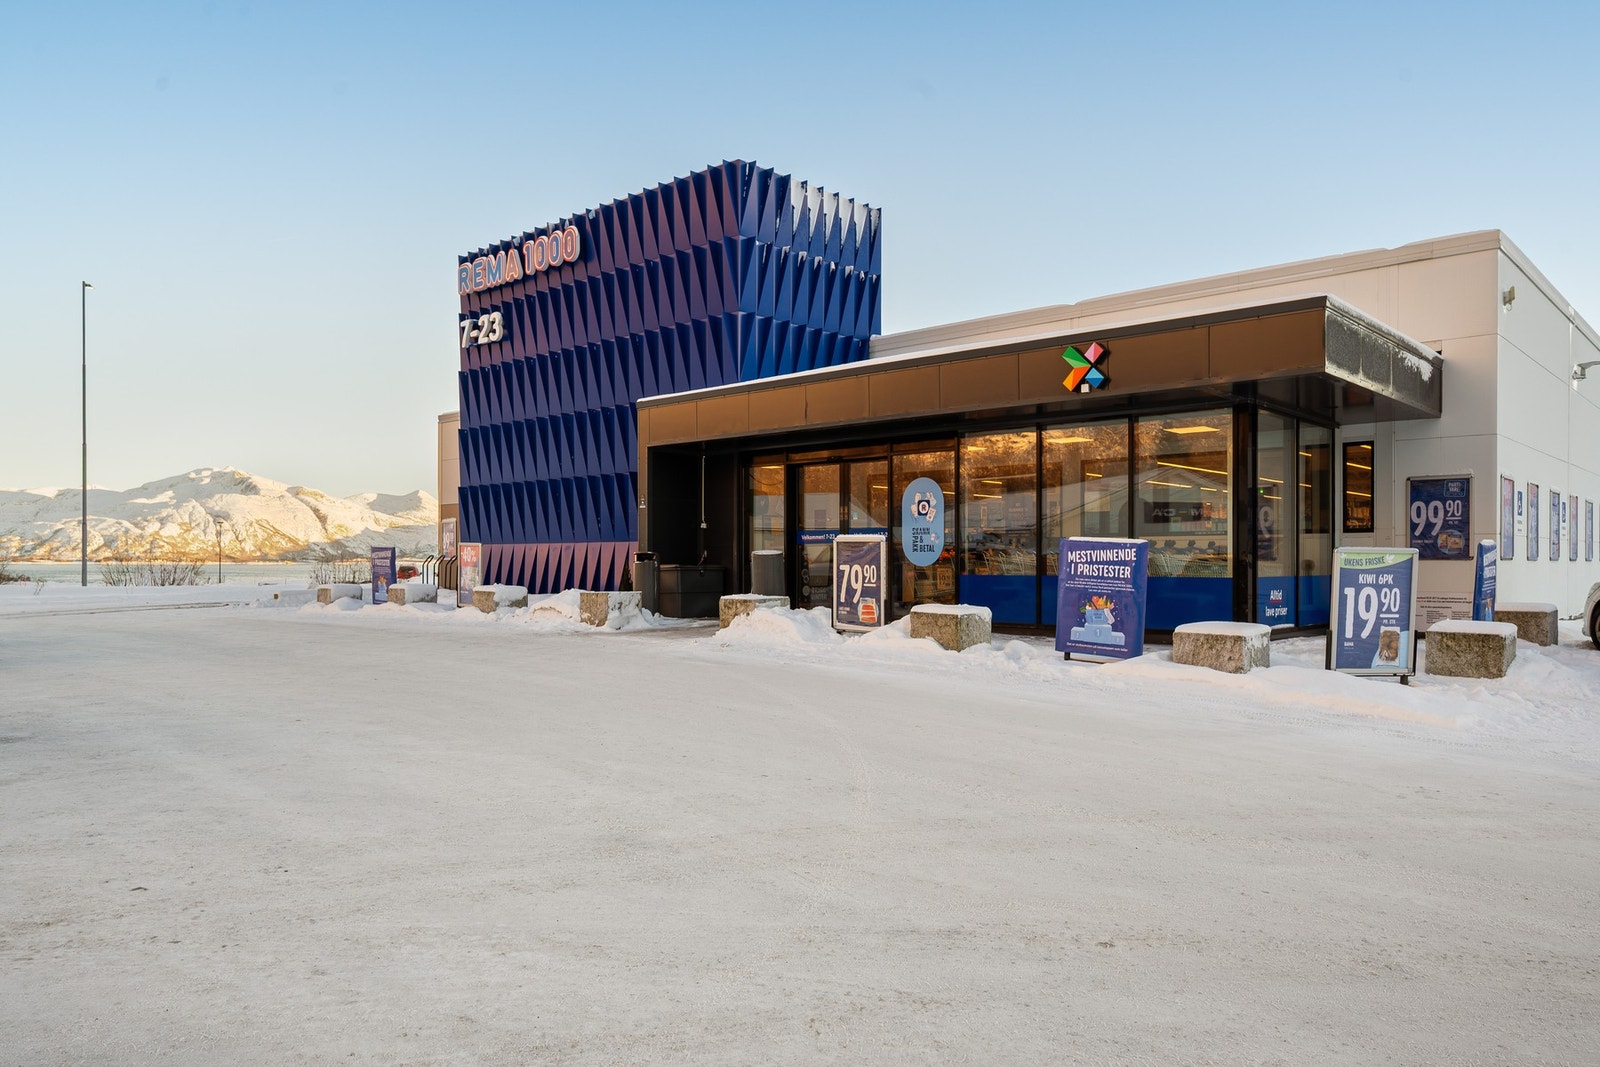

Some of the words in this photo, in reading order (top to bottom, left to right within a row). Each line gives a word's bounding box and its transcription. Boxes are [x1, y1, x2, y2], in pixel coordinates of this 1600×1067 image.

[458, 249, 523, 295] REMA
[523, 226, 580, 276] 1000
[460, 311, 503, 348] 7-23
[1411, 500, 1445, 537] 99
[1445, 500, 1462, 517] 90
[919, 544, 936, 553] BETAL
[1067, 548, 1137, 562] MESTVINNENDE
[1344, 557, 1364, 567] UKENS
[1365, 555, 1386, 566] FRISKE
[1071, 563, 1075, 575] I
[1077, 563, 1131, 578] PRISTESTER
[1358, 573, 1376, 585] KIWI
[1378, 573, 1394, 585] 6PK
[839, 564, 863, 604] 79
[863, 564, 877, 584] 90
[1344, 586, 1379, 640] 19
[1380, 587, 1401, 613] 90
